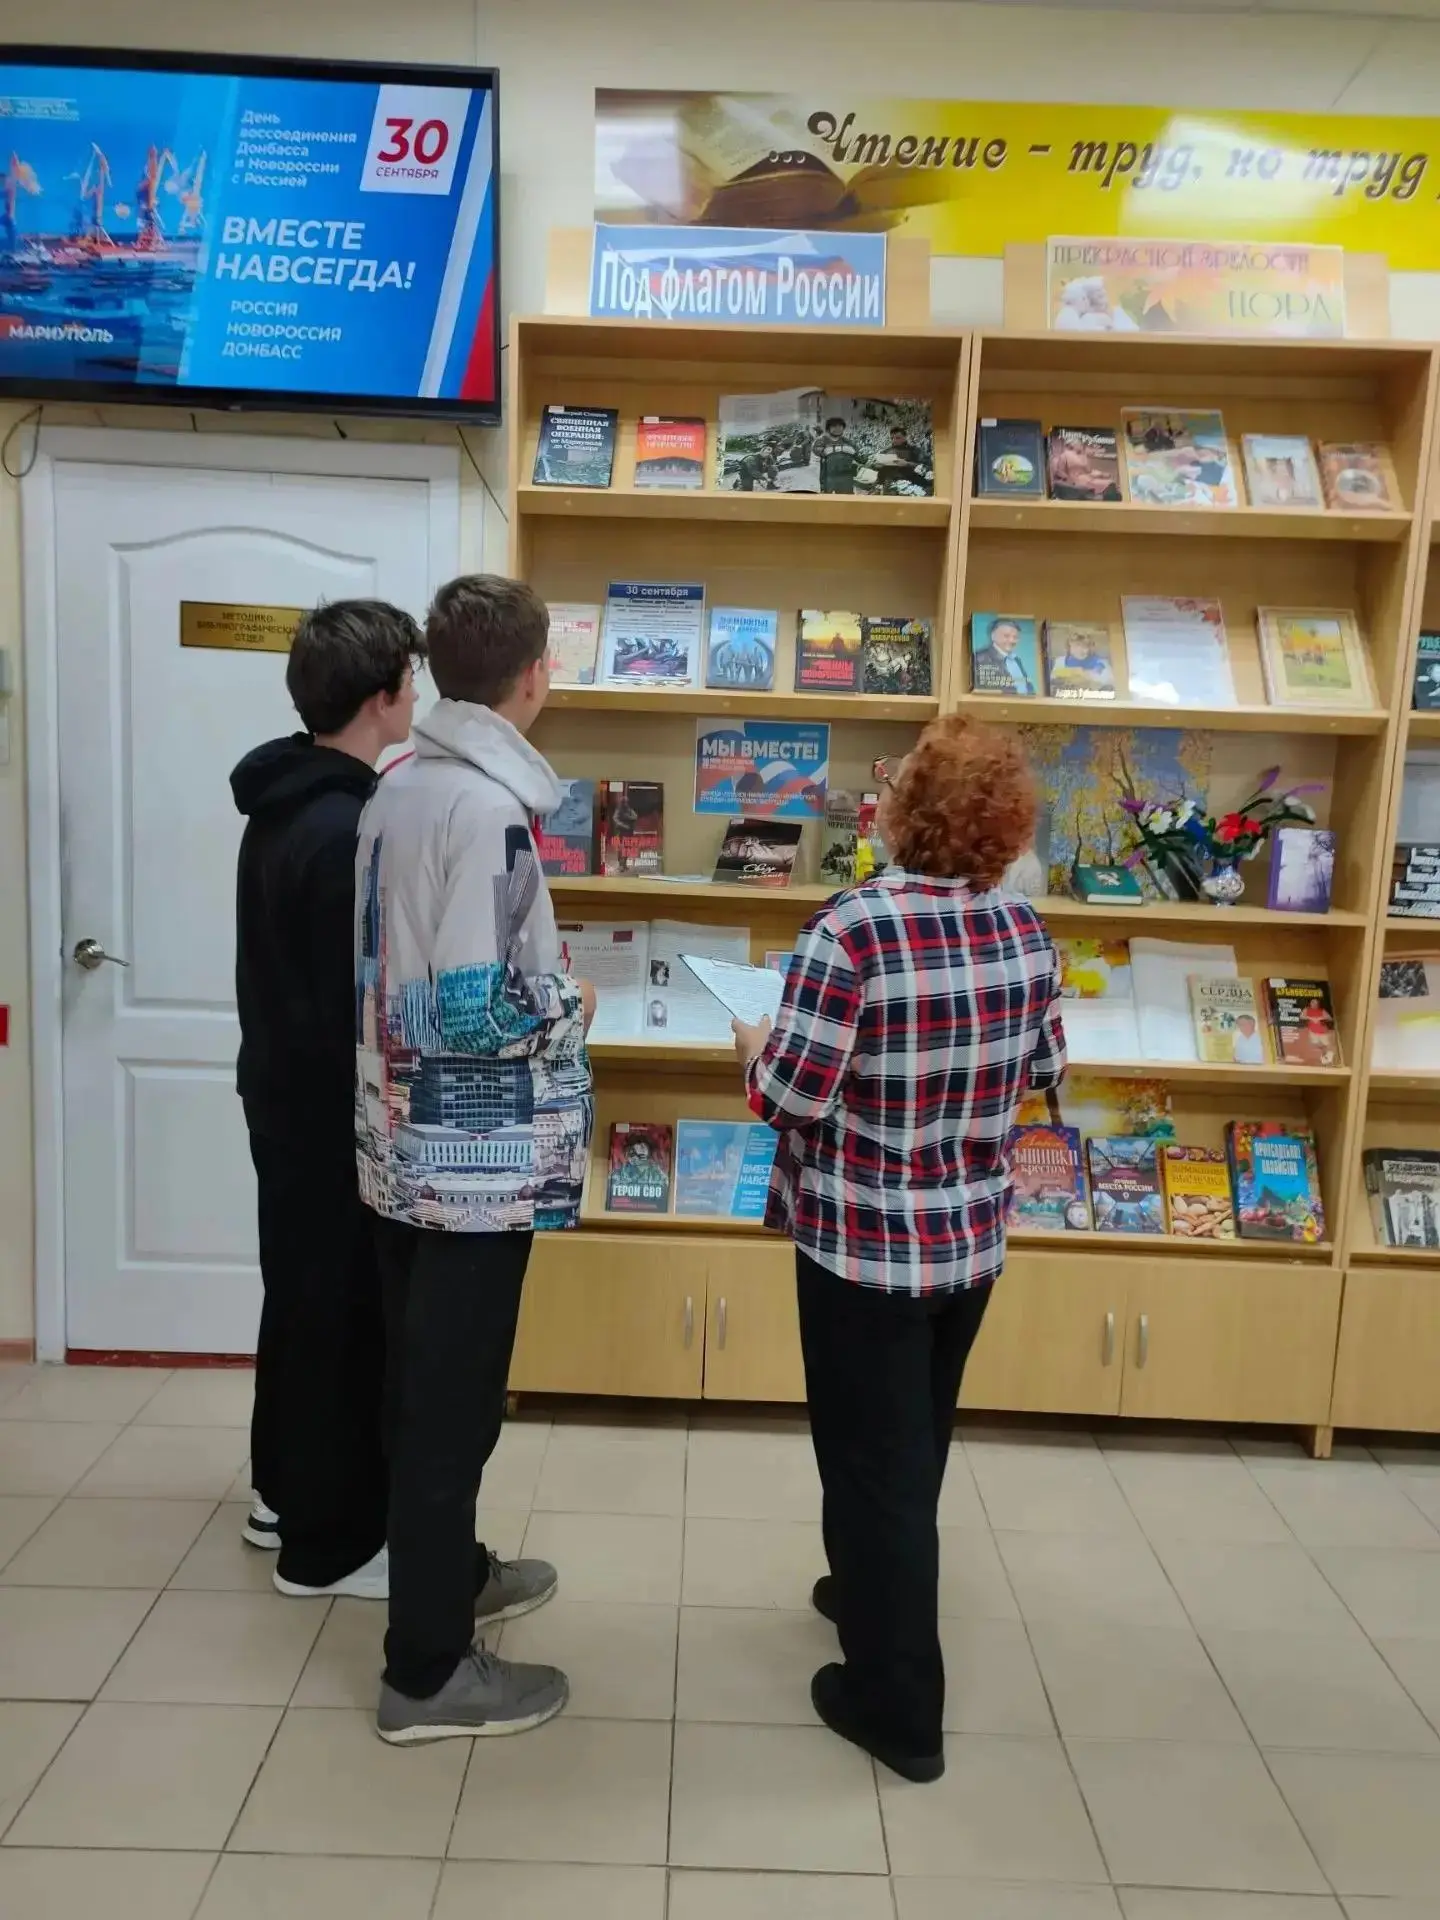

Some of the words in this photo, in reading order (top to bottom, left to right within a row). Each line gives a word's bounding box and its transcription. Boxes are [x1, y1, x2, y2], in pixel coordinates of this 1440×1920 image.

[241, 109, 281, 124] День
[239, 128, 357, 143] воссоединения
[377, 117, 449, 166] 30
[236, 141, 309, 156] Донбасса
[234, 159, 244, 168] и
[248, 158, 340, 174] Новороссии
[375, 167, 439, 181] СЕНТЯБРЯ
[1067, 139, 1203, 192] труд,
[1226, 145, 1283, 181] но
[1303, 147, 1429, 200] труд
[231, 174, 240, 184] с
[244, 172, 307, 187] Россией
[221, 216, 366, 251] ВМЕСТЕ
[1053, 245, 1193, 269] ПРЕКРАСНОЙ
[215, 255, 416, 291] НАВСЕГДА!
[598, 252, 655, 319] Под
[660, 256, 767, 319] флагом
[777, 255, 880, 319] России
[230, 300, 299, 317] РОССИЯ
[1229, 290, 1332, 321] ПОРА
[8, 325, 114, 345] МАРИУПОЛЬ
[226, 322, 342, 342] НОВОРОССИЯ
[222, 341, 304, 360] ДОНБАСС
[550, 417, 609, 427] СВЯЩЕННАЯ
[556, 425, 601, 433] ВОЕННАЯ
[626, 586, 639, 595] 30
[641, 587, 689, 598] сентября
[197, 620, 297, 635] БИБЛИОГРАФИЧЕСКИ
[234, 633, 265, 643] ОТДЕЛ
[702, 739, 736, 757] МЫ
[741, 740, 820, 760] ВМЕСТЕ!
[1013, 1148, 1078, 1165] ЫШИВКИ
[642, 1184, 662, 1198] СВО
